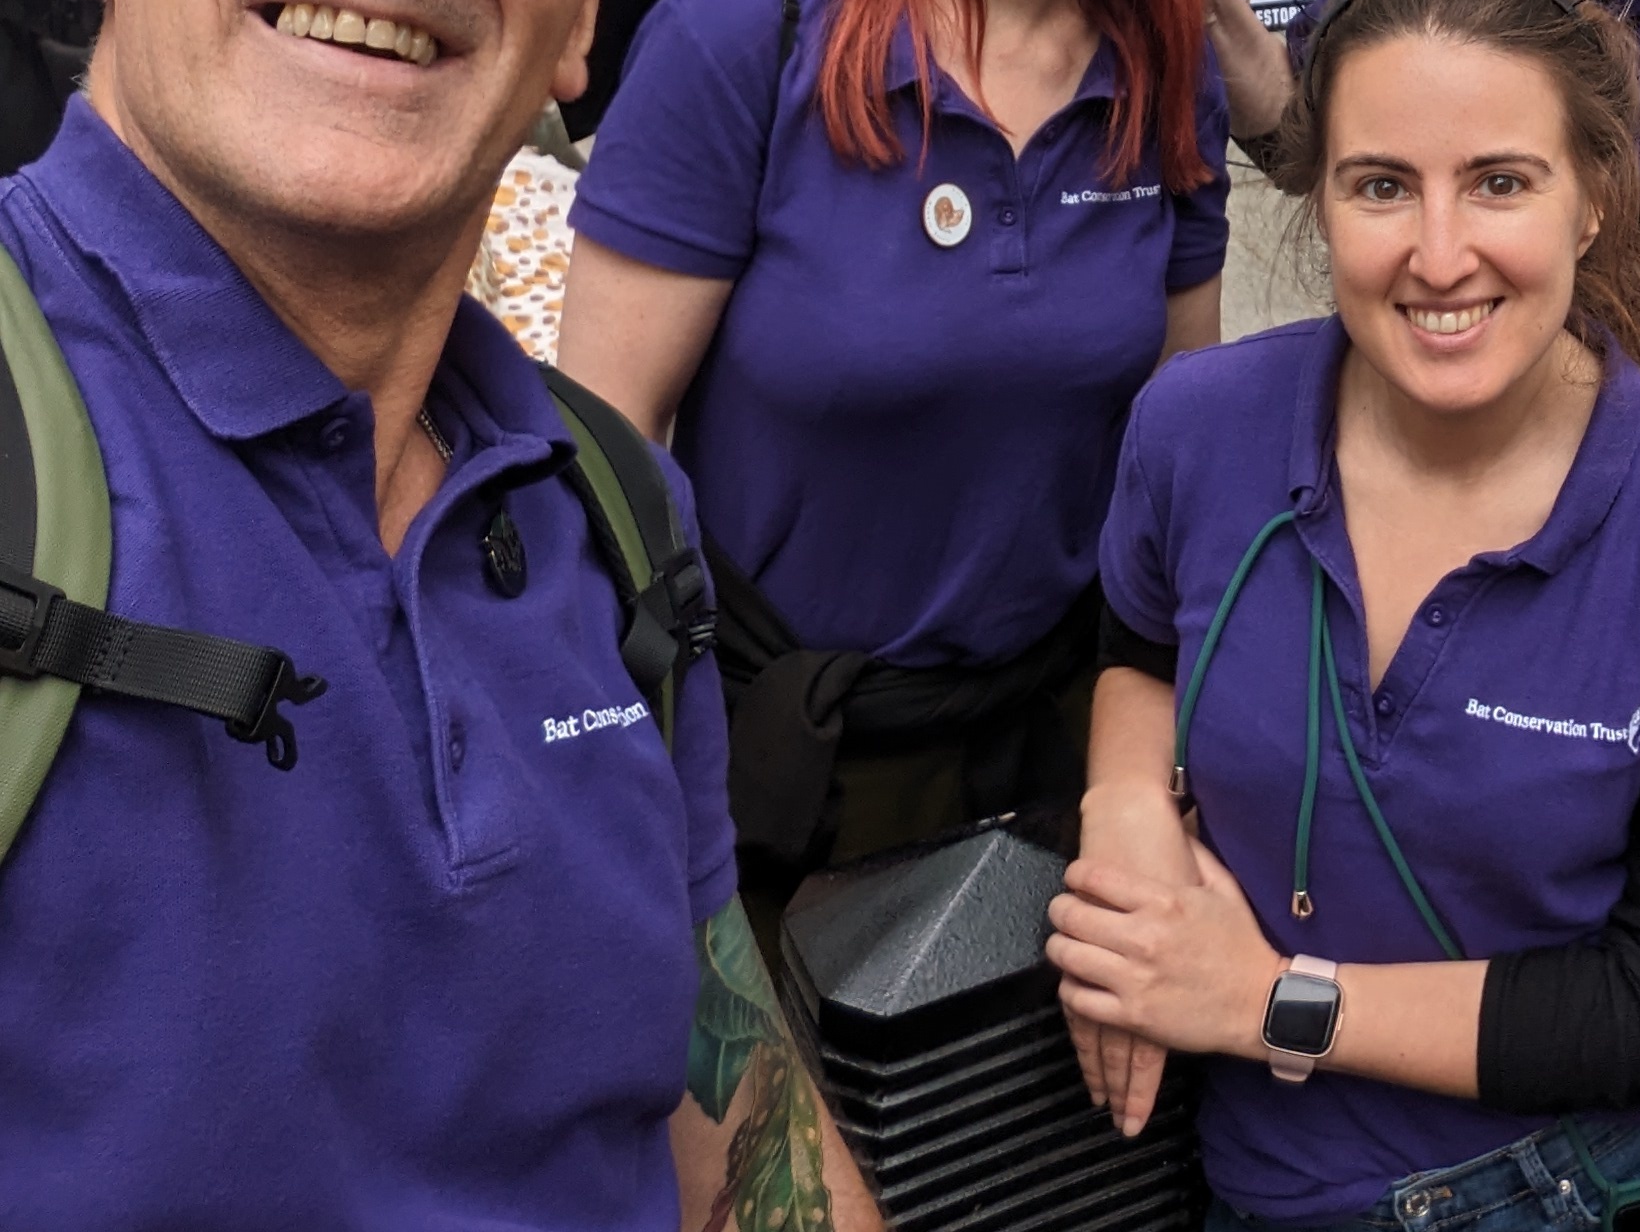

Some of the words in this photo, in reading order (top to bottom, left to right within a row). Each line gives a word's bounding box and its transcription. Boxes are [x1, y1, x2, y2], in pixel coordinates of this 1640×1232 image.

[543, 717, 580, 743] Bat
[1465, 697, 1491, 720] Bat
[1492, 705, 1587, 738] Conservation
[1589, 722, 1629, 742] Trust
